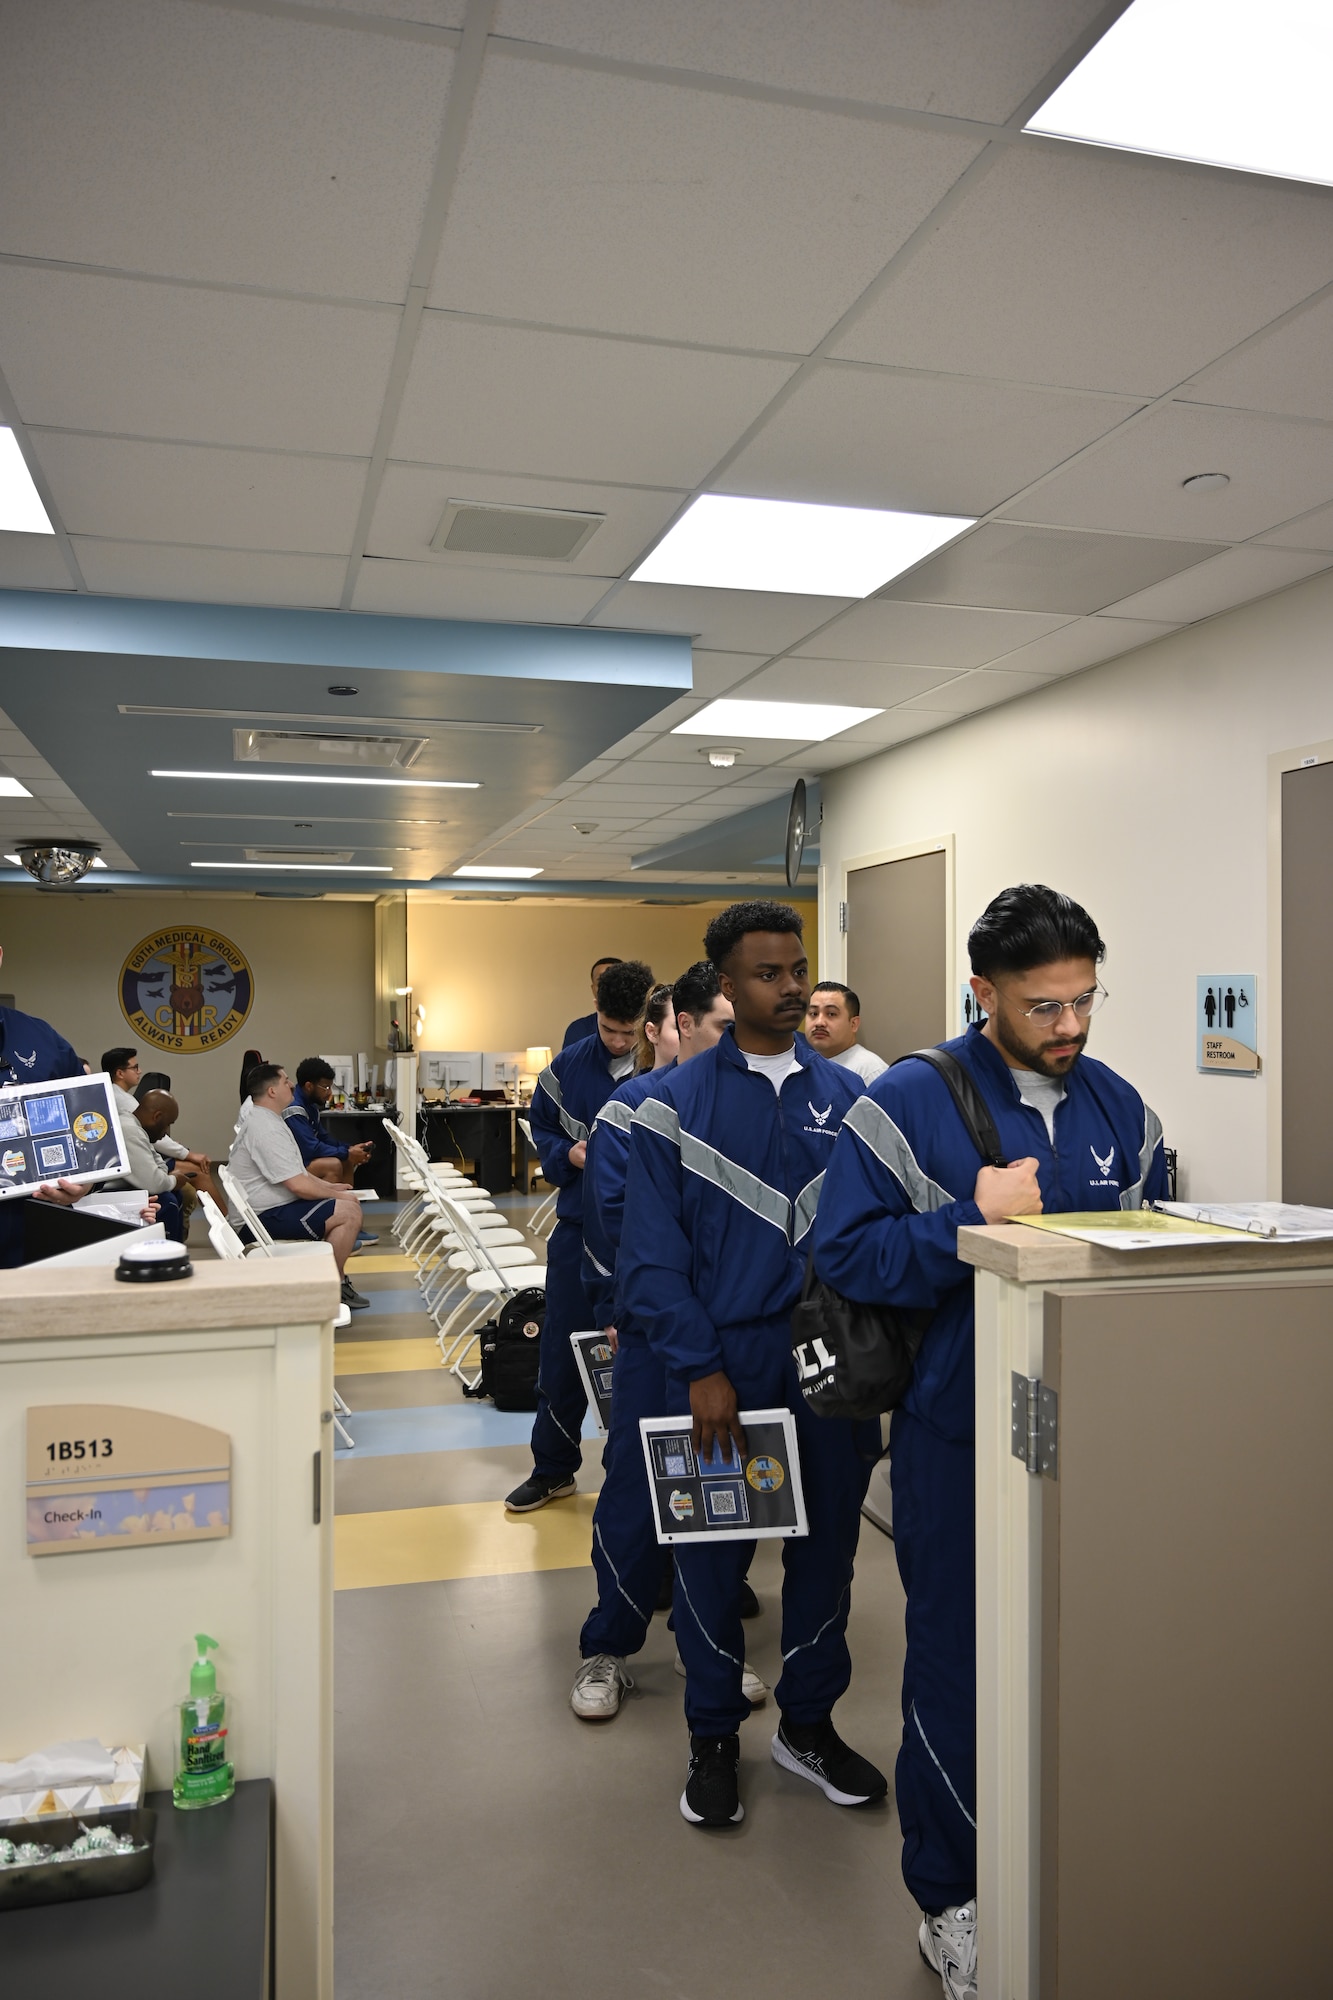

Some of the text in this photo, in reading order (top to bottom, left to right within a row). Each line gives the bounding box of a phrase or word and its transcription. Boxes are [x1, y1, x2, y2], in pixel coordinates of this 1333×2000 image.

[131, 932, 241, 969] 60TH MEDICAL GROUP
[154, 1005, 220, 1028] CMR
[134, 1014, 239, 1047] ALWAYS READY
[1206, 1041, 1223, 1049] STAFF
[1206, 1051, 1236, 1059] RESTROOM
[46, 1438, 114, 1461] 1B513
[44, 1508, 103, 1524] Check-In
[187, 1742, 211, 1755] Hand
[187, 1751, 225, 1767] Sanitizer
